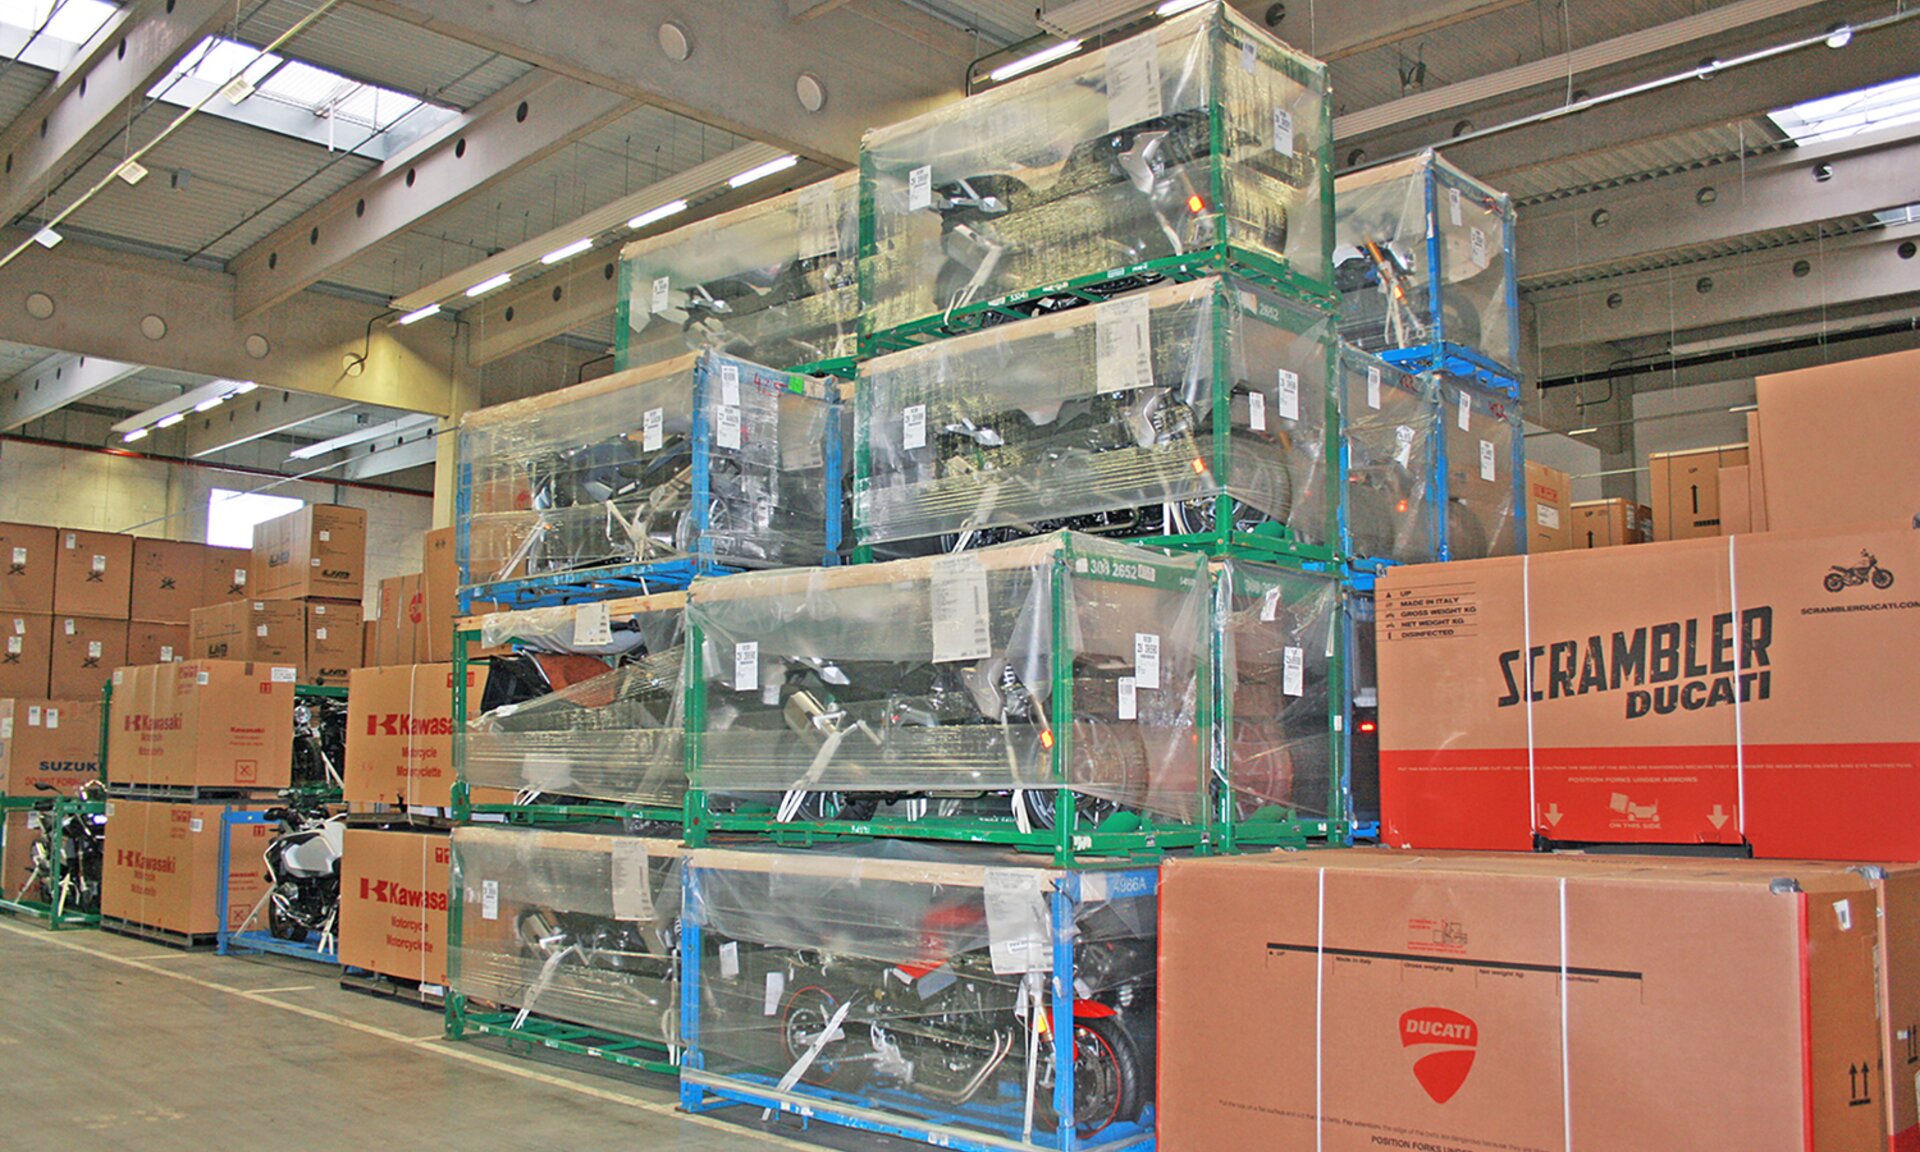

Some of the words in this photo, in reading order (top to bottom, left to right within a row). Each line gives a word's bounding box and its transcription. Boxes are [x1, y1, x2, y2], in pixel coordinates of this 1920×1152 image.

[1112, 562, 1137, 580] 2652
[1430, 607, 1462, 615] WEIGHT
[1418, 619, 1450, 627] WEIGHT
[1401, 629, 1455, 638] DISINFECTED
[1498, 605, 1773, 707] SCRAMBLER
[1626, 670, 1771, 719] DUCATI
[400, 714, 453, 735] Kawasa
[390, 881, 448, 911] Kawasa
[1424, 964, 1444, 972] weight
[1492, 969, 1514, 978] weight
[1406, 1019, 1471, 1039] DUCATI
[1371, 1135, 1410, 1149] POSITION
